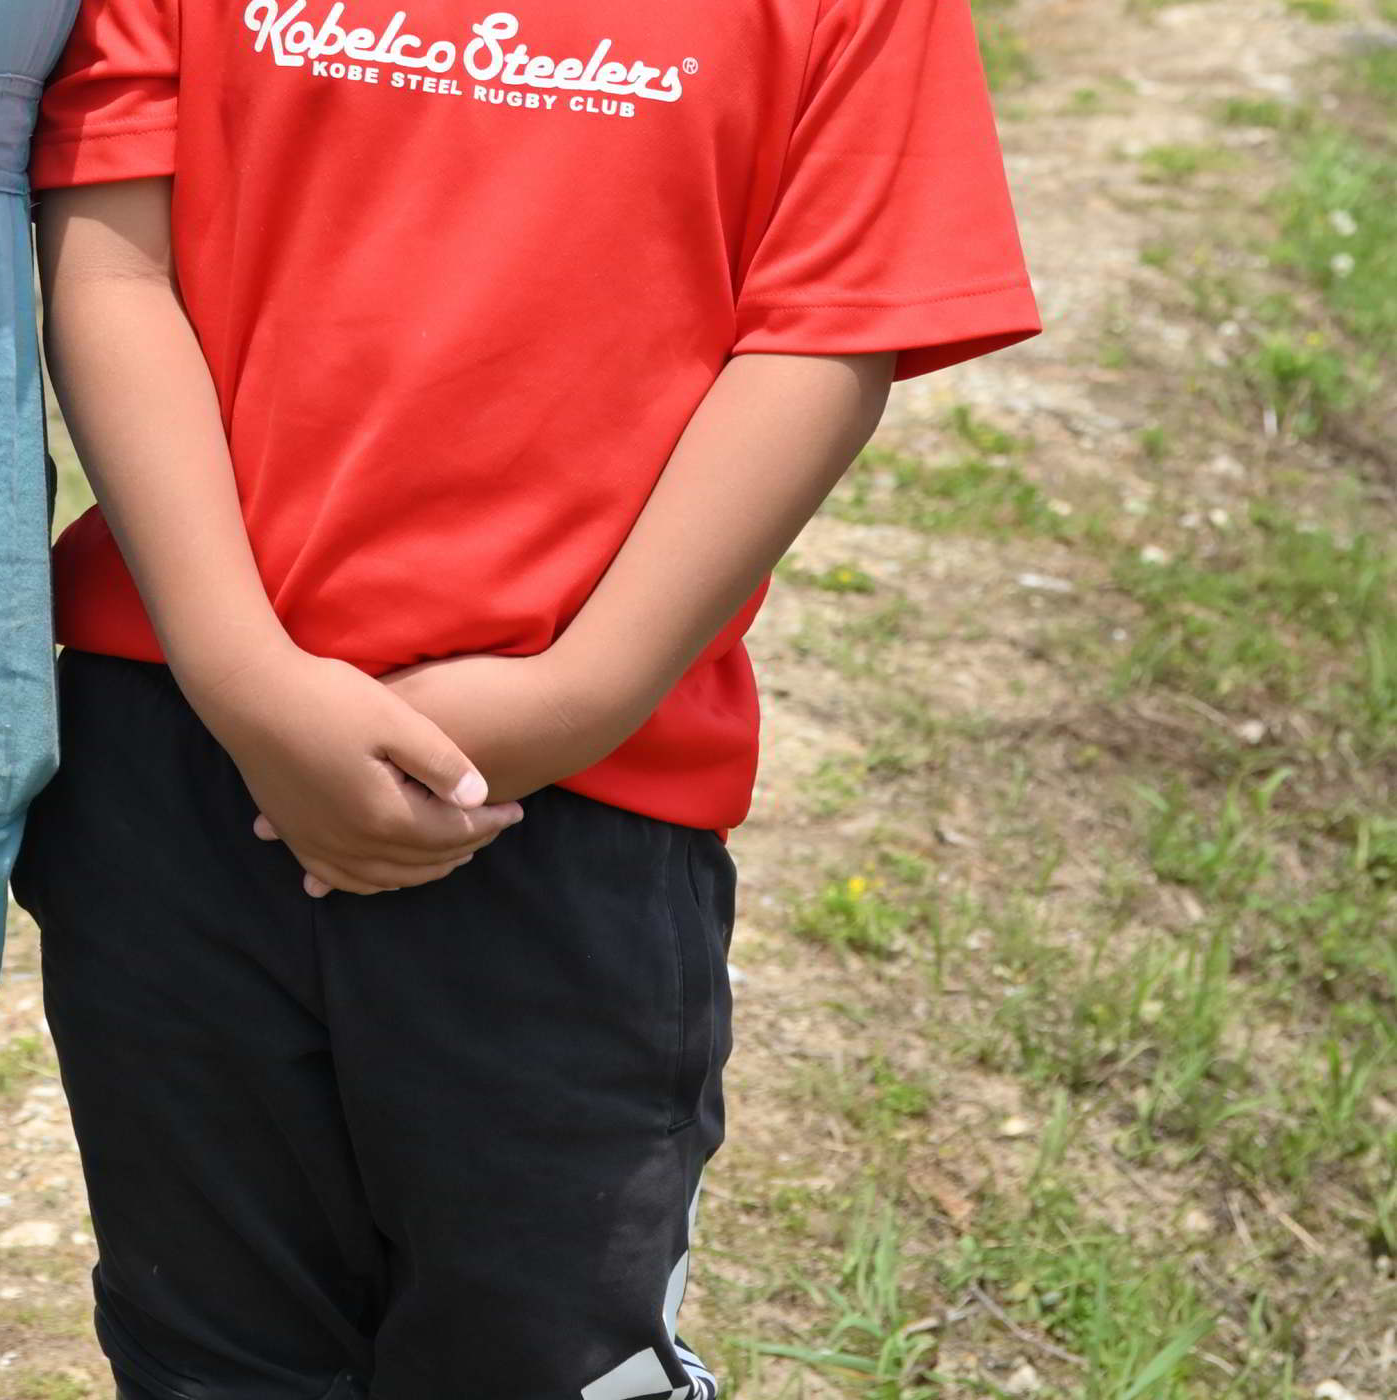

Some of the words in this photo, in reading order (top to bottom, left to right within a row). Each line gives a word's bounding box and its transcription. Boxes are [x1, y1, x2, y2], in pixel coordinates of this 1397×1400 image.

[312, 60, 380, 84] KOBE
[390, 71, 464, 96] STEEL
[473, 84, 558, 111] RUGBY
[568, 95, 636, 118] CLUB
